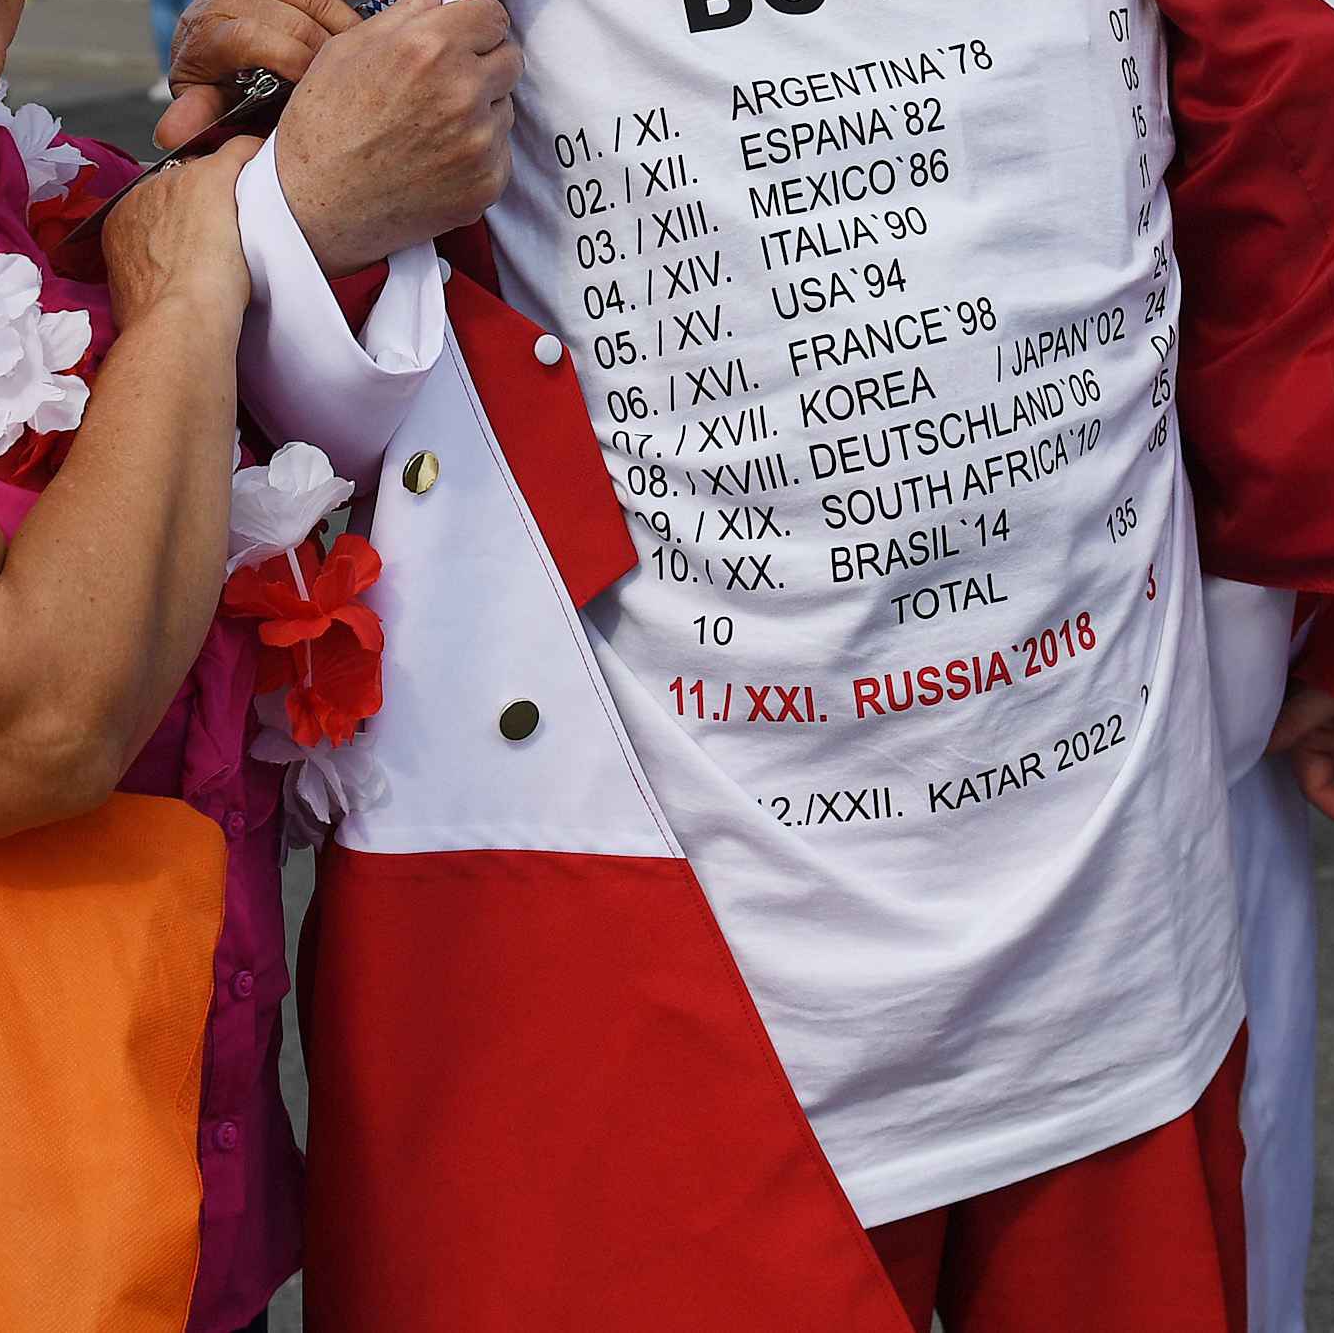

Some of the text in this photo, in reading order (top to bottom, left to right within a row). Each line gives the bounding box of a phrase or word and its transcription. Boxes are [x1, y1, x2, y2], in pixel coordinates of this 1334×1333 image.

[554, 128, 603, 168] 01.
[632, 107, 680, 147] XI.
[1109, 7, 1130, 43] 07
[566, 178, 615, 219] 02.
[640, 154, 698, 197] XII.
[1121, 55, 1140, 91] 03
[576, 229, 626, 270] 03.
[651, 200, 719, 249] XIII.
[1132, 104, 1147, 139] 15
[583, 280, 636, 320] 04.
[662, 250, 732, 300] XIV.
[1139, 153, 1151, 189] 11
[594, 330, 647, 370] 05.
[673, 304, 733, 351] XV.
[1137, 201, 1152, 237] 14
[607, 386, 659, 424] 06.
[685, 358, 759, 406] XVI.
[1153, 239, 1168, 280] 24
[698, 405, 778, 453] XVII.
[799, 366, 937, 428] KOREA
[1144, 285, 1166, 324] 24
[627, 464, 678, 498] 08.
[700, 453, 800, 496] XVIII.
[717, 506, 791, 541] XIX.
[821, 470, 953, 530] SOUTH
[651, 545, 698, 583] 10.
[721, 554, 785, 591] XX.
[693, 496, 1137, 646] 10 TOTAL 135
[744, 685, 828, 723] XXI.
[928, 752, 1046, 813] KATAR
[1053, 714, 1126, 772] 2022
